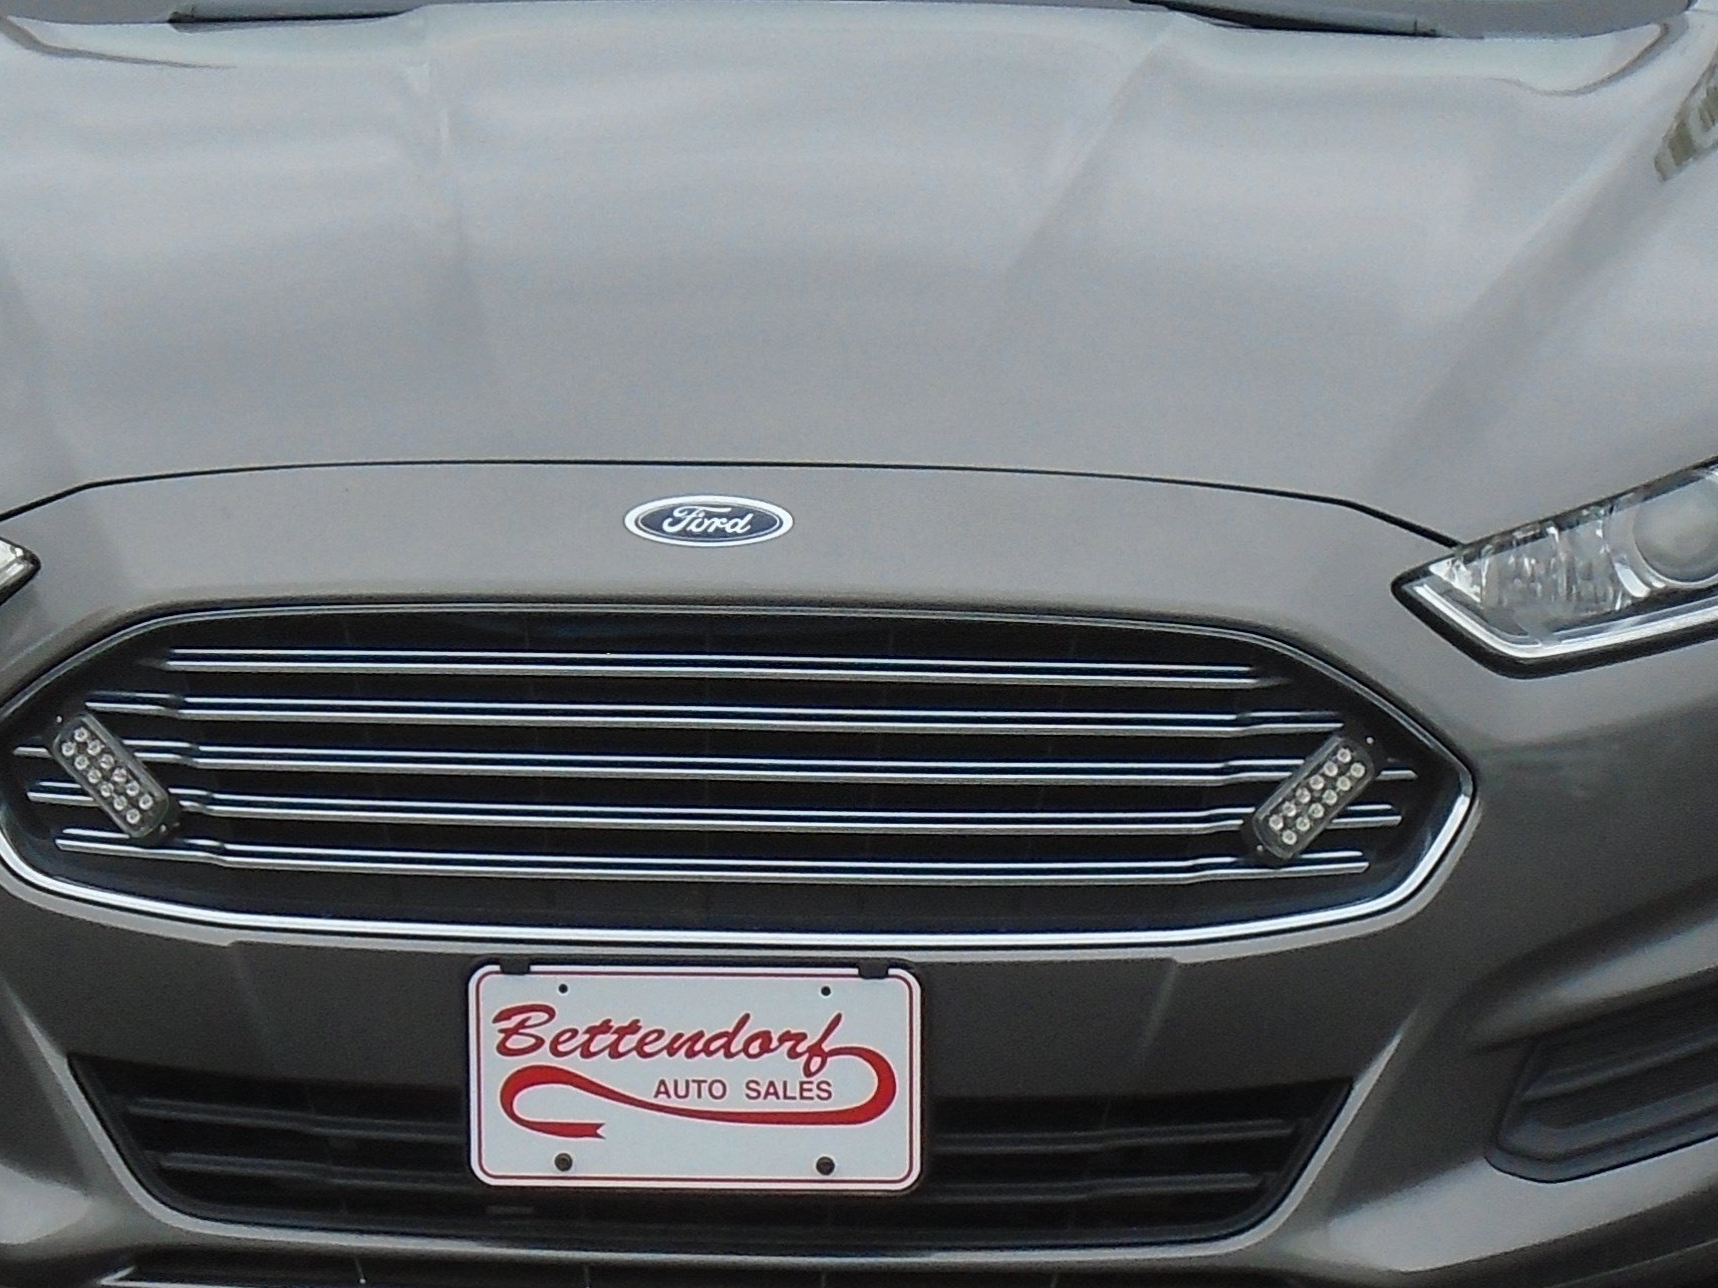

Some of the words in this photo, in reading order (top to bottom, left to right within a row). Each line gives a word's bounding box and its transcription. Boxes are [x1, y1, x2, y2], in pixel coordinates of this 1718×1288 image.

[661, 505, 754, 534] Ford
[491, 1003, 844, 1078] Bettendorf
[653, 1079, 728, 1101] AUTO
[743, 1079, 834, 1102] SALES
